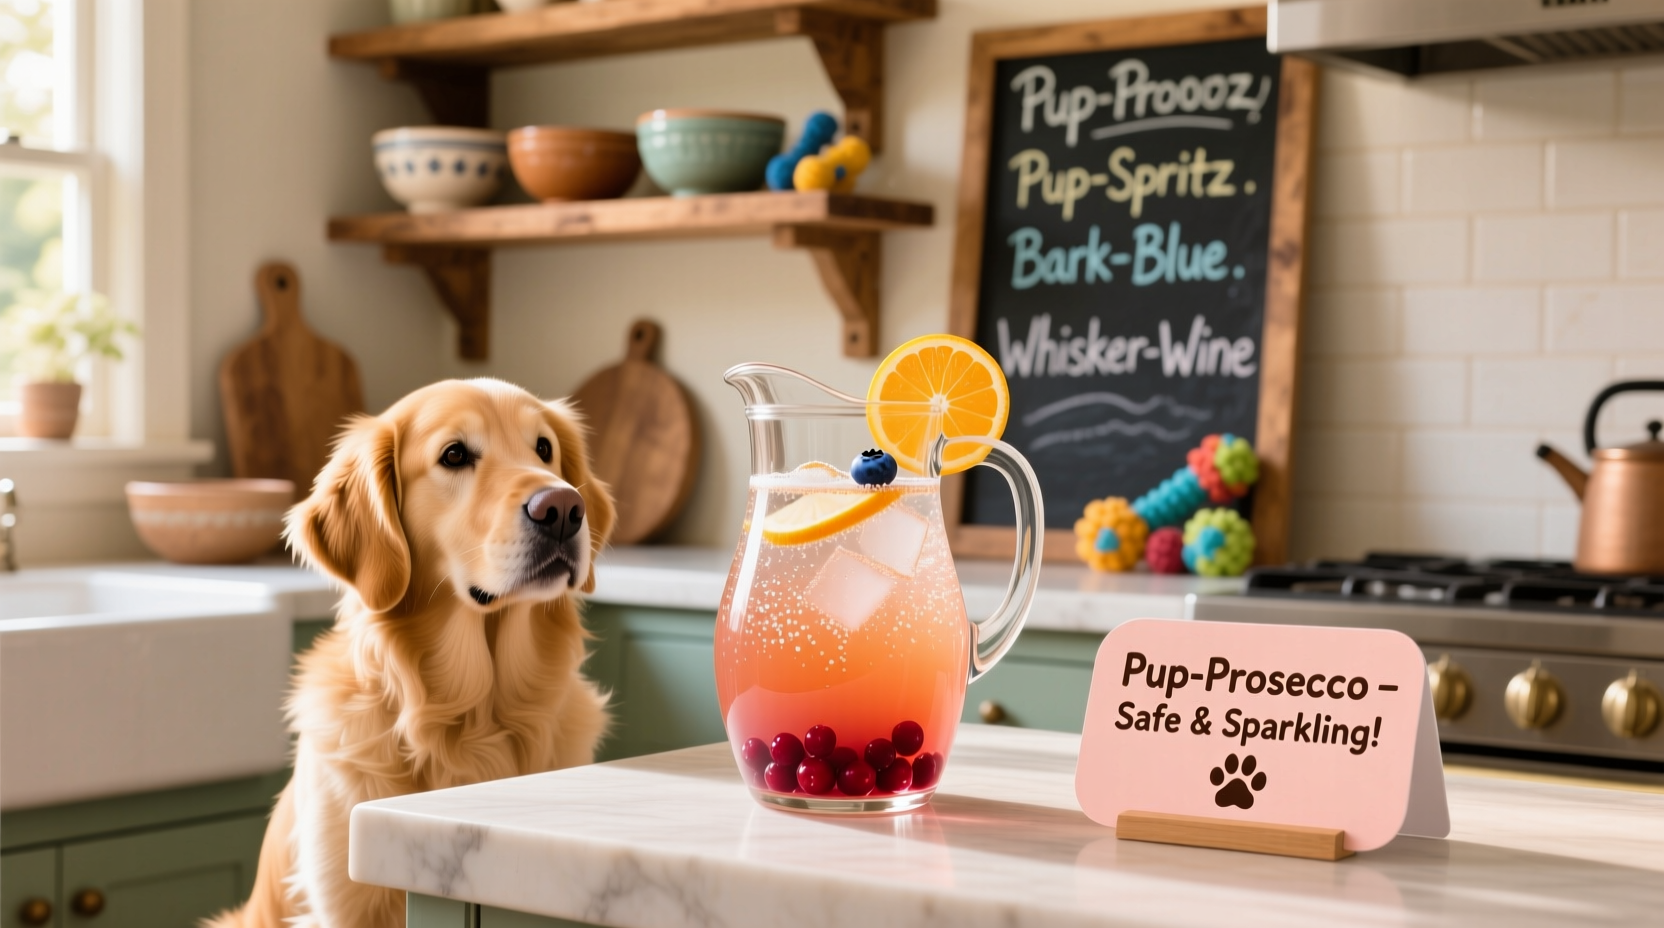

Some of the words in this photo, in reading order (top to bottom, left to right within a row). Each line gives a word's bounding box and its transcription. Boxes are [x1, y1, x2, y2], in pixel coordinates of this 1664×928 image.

[1007, 221, 1246, 289] Bark-Blue.
[997, 313, 1257, 378] Whisker-Wine
[1122, 651, 1369, 700] Pup-Prosecco
[1114, 701, 1181, 733] Safe
[1190, 706, 1212, 735] &
[1221, 707, 1382, 755] Sparkling!
